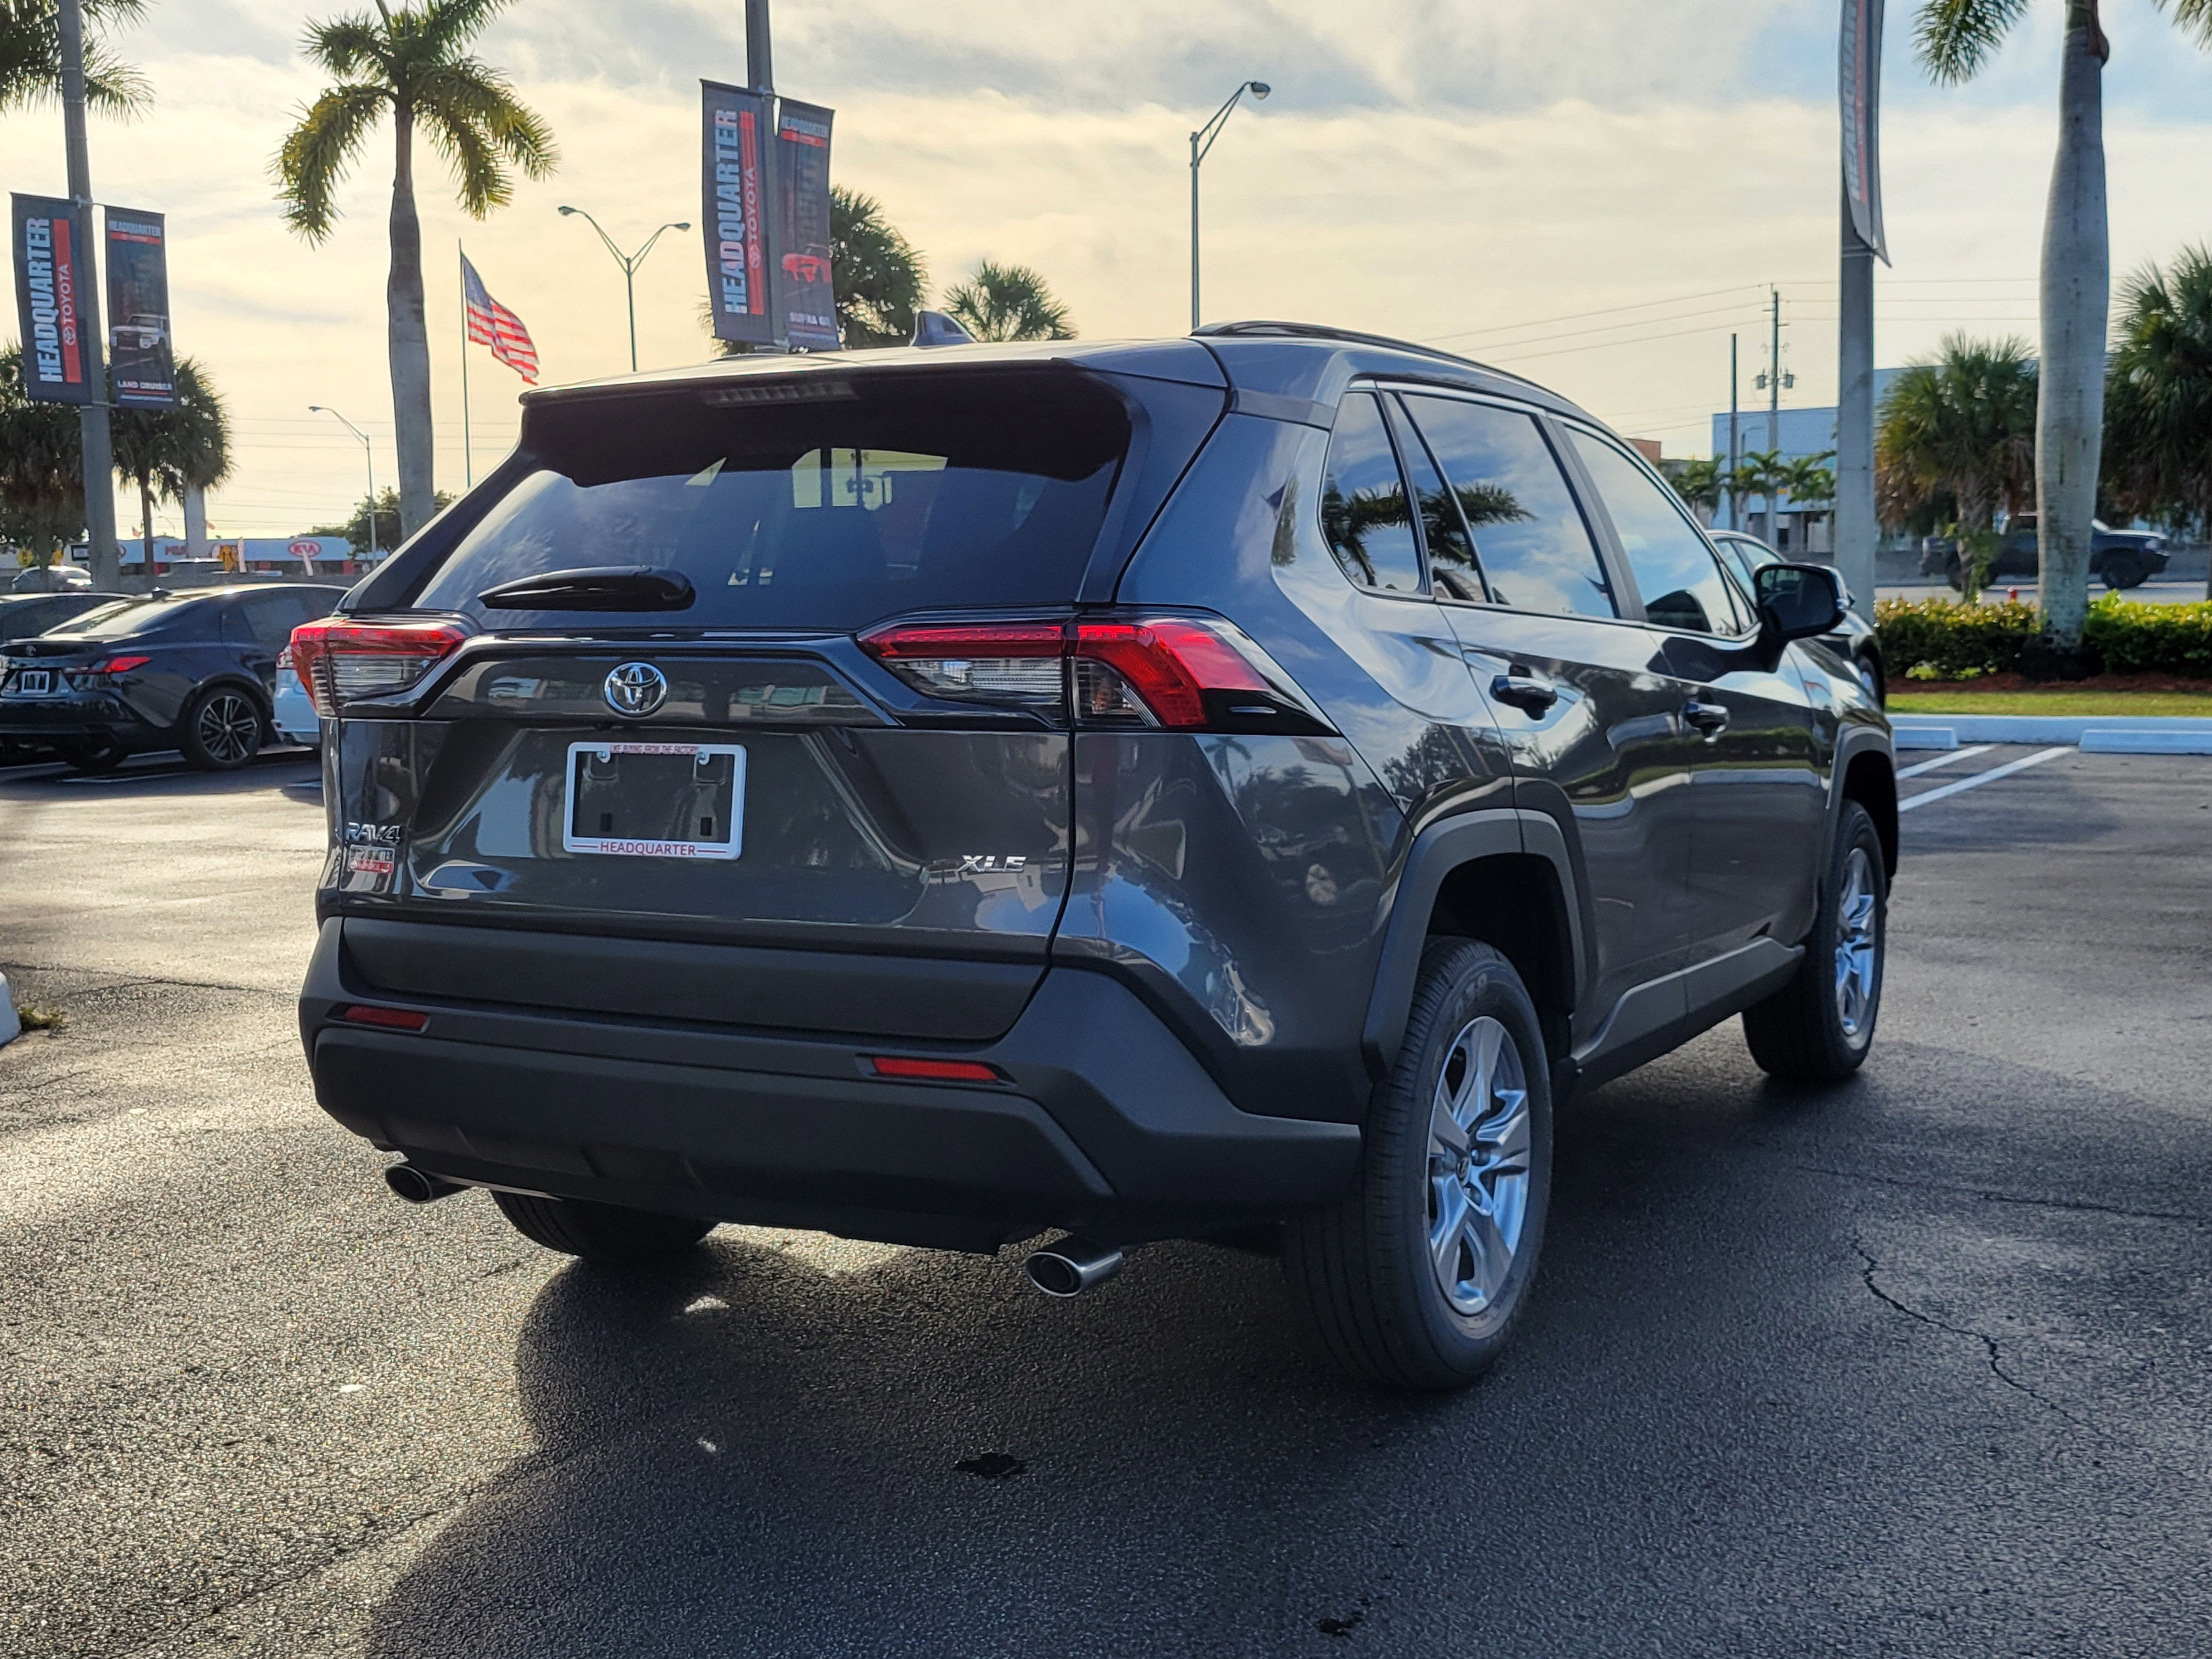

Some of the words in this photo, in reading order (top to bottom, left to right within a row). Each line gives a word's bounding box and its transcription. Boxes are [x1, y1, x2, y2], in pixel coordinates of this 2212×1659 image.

[715, 109, 748, 315] HEADQUARTER
[743, 167, 760, 246] TOYOTA
[26, 218, 63, 382] HEADQUARTER
[58, 264, 75, 325] TOYOTA
[117, 380, 138, 388] LAND
[139, 381, 173, 390] CRUISER
[293, 545, 317, 556] KIA
[346, 822, 401, 845] RAV4
[600, 842, 697, 856] HEADQUARTER
[956, 855, 1028, 873] XLE
